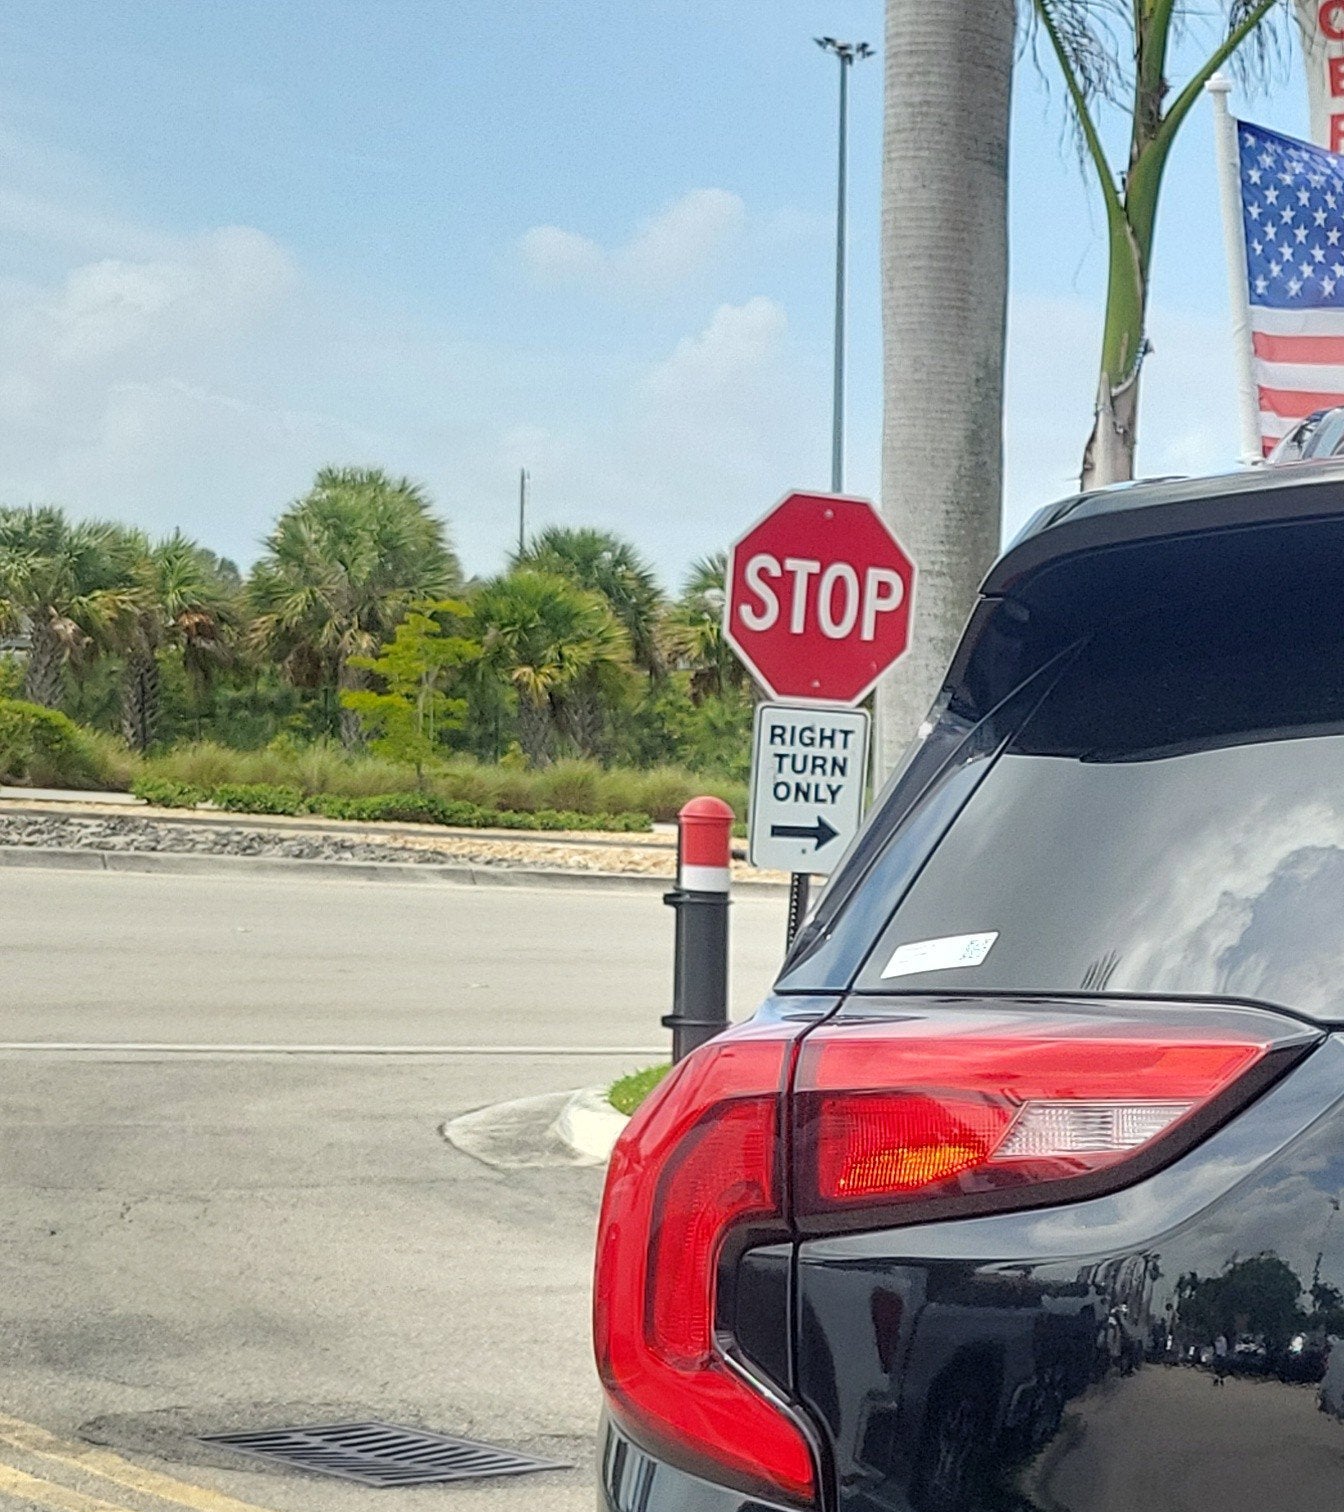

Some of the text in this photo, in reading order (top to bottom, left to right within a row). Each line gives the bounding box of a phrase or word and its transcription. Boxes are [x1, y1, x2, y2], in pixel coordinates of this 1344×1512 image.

[739, 553, 905, 642] STOP
[769, 725, 856, 750] RIGHT
[773, 752, 849, 778] TURN
[772, 781, 844, 804] ONLY
